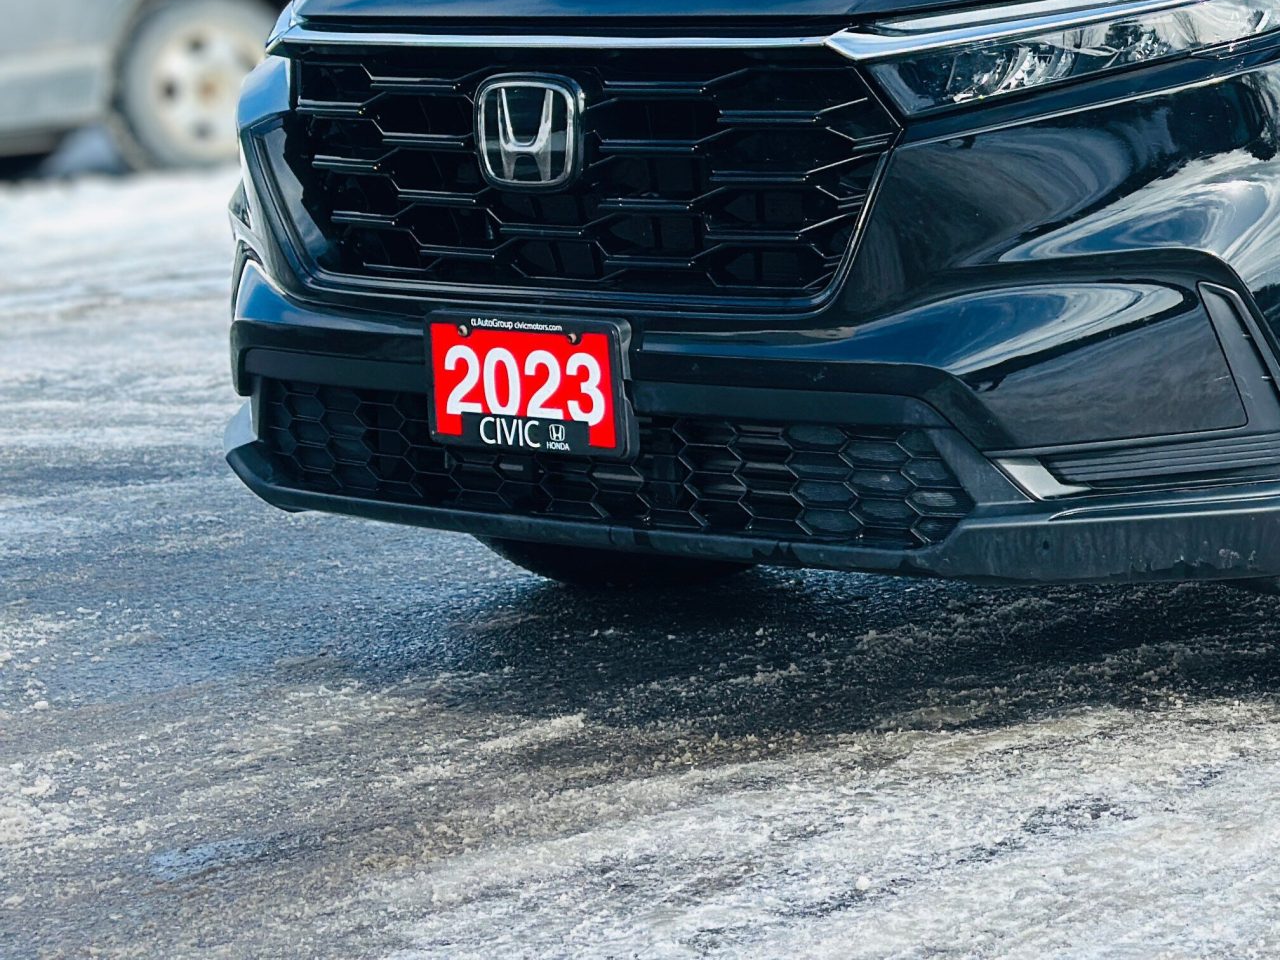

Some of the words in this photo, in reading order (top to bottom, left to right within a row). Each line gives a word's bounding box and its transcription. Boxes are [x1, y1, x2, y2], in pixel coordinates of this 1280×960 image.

[514, 321, 563, 331] civicmotors.com
[444, 345, 606, 426] 2023
[479, 416, 541, 448] CIVIC
[546, 441, 570, 451] HONDA
